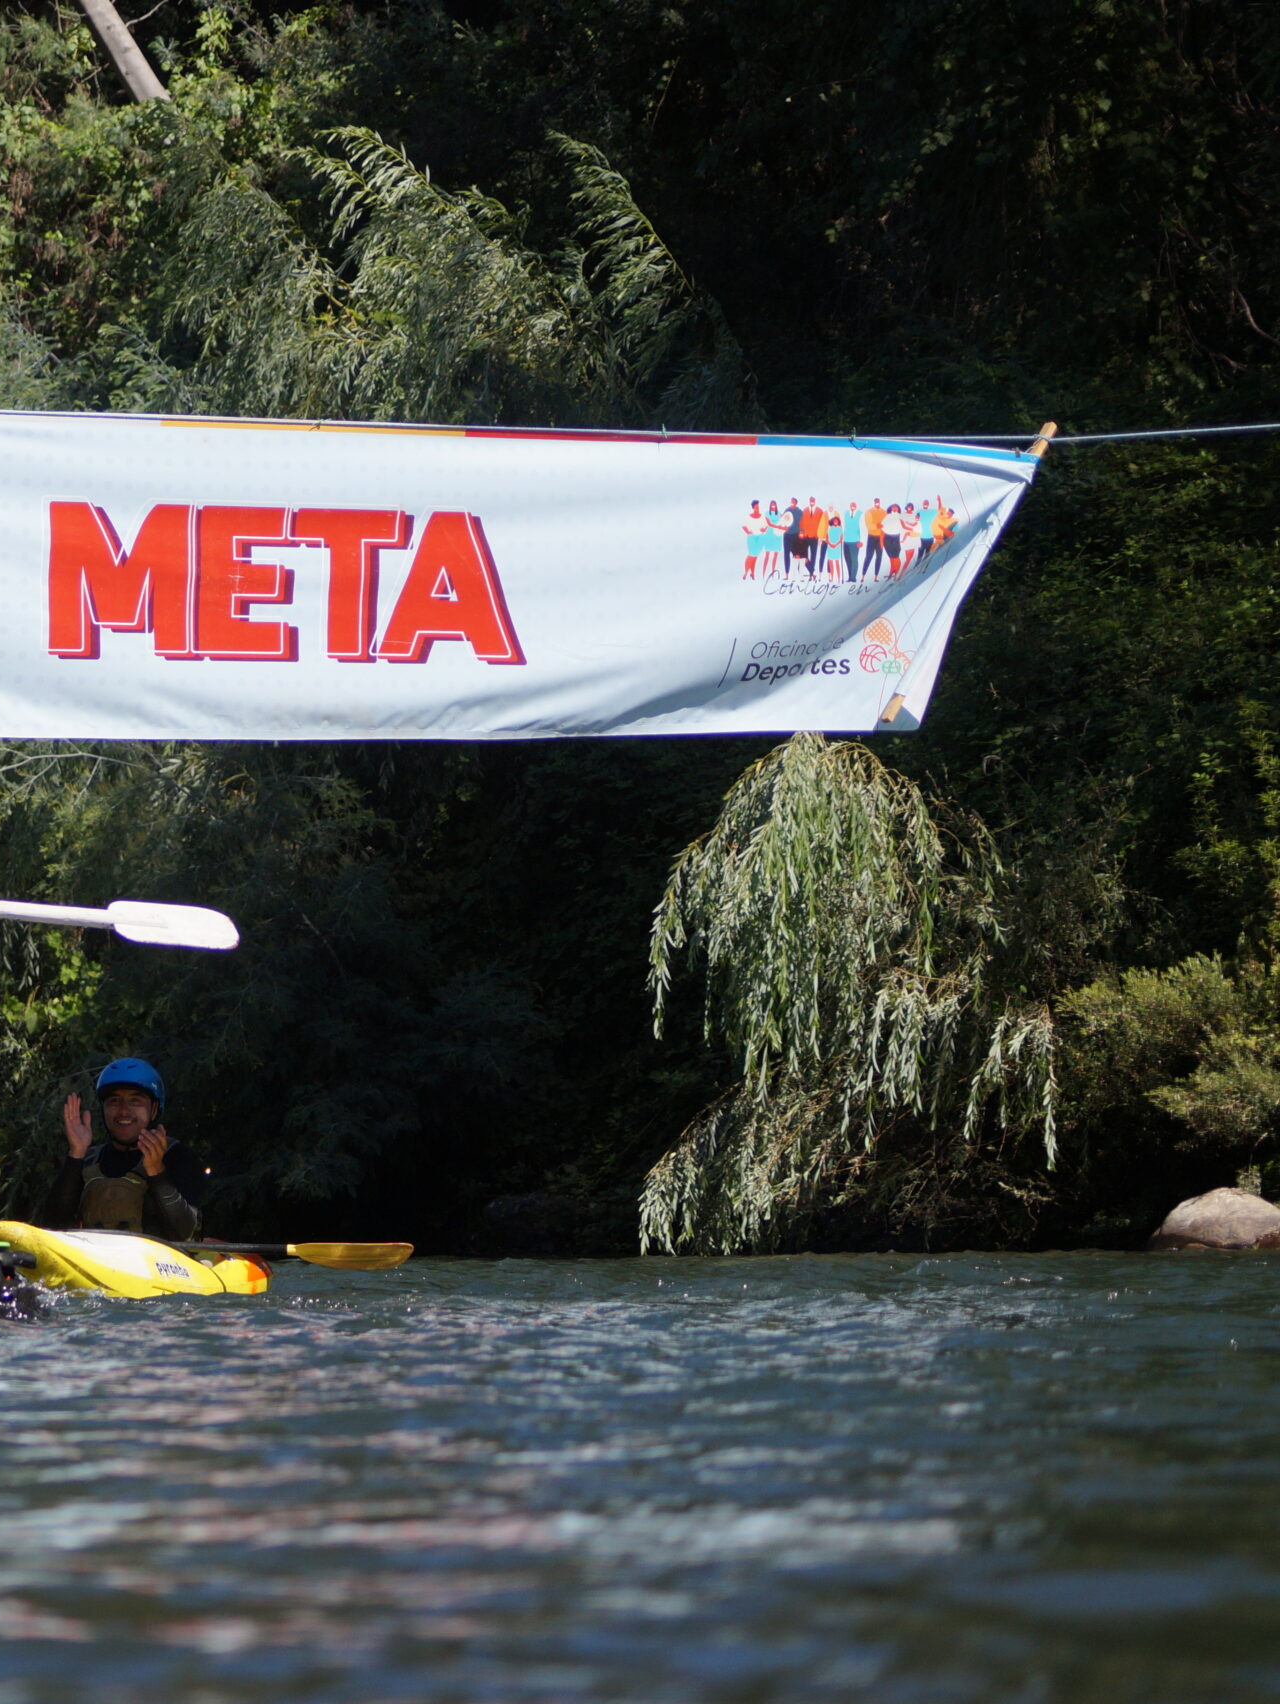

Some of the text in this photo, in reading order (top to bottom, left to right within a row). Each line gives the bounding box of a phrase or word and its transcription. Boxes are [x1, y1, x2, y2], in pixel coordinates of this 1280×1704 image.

[42, 496, 527, 665] META
[763, 569, 841, 611] Contigo
[740, 656, 851, 686] Deportes
